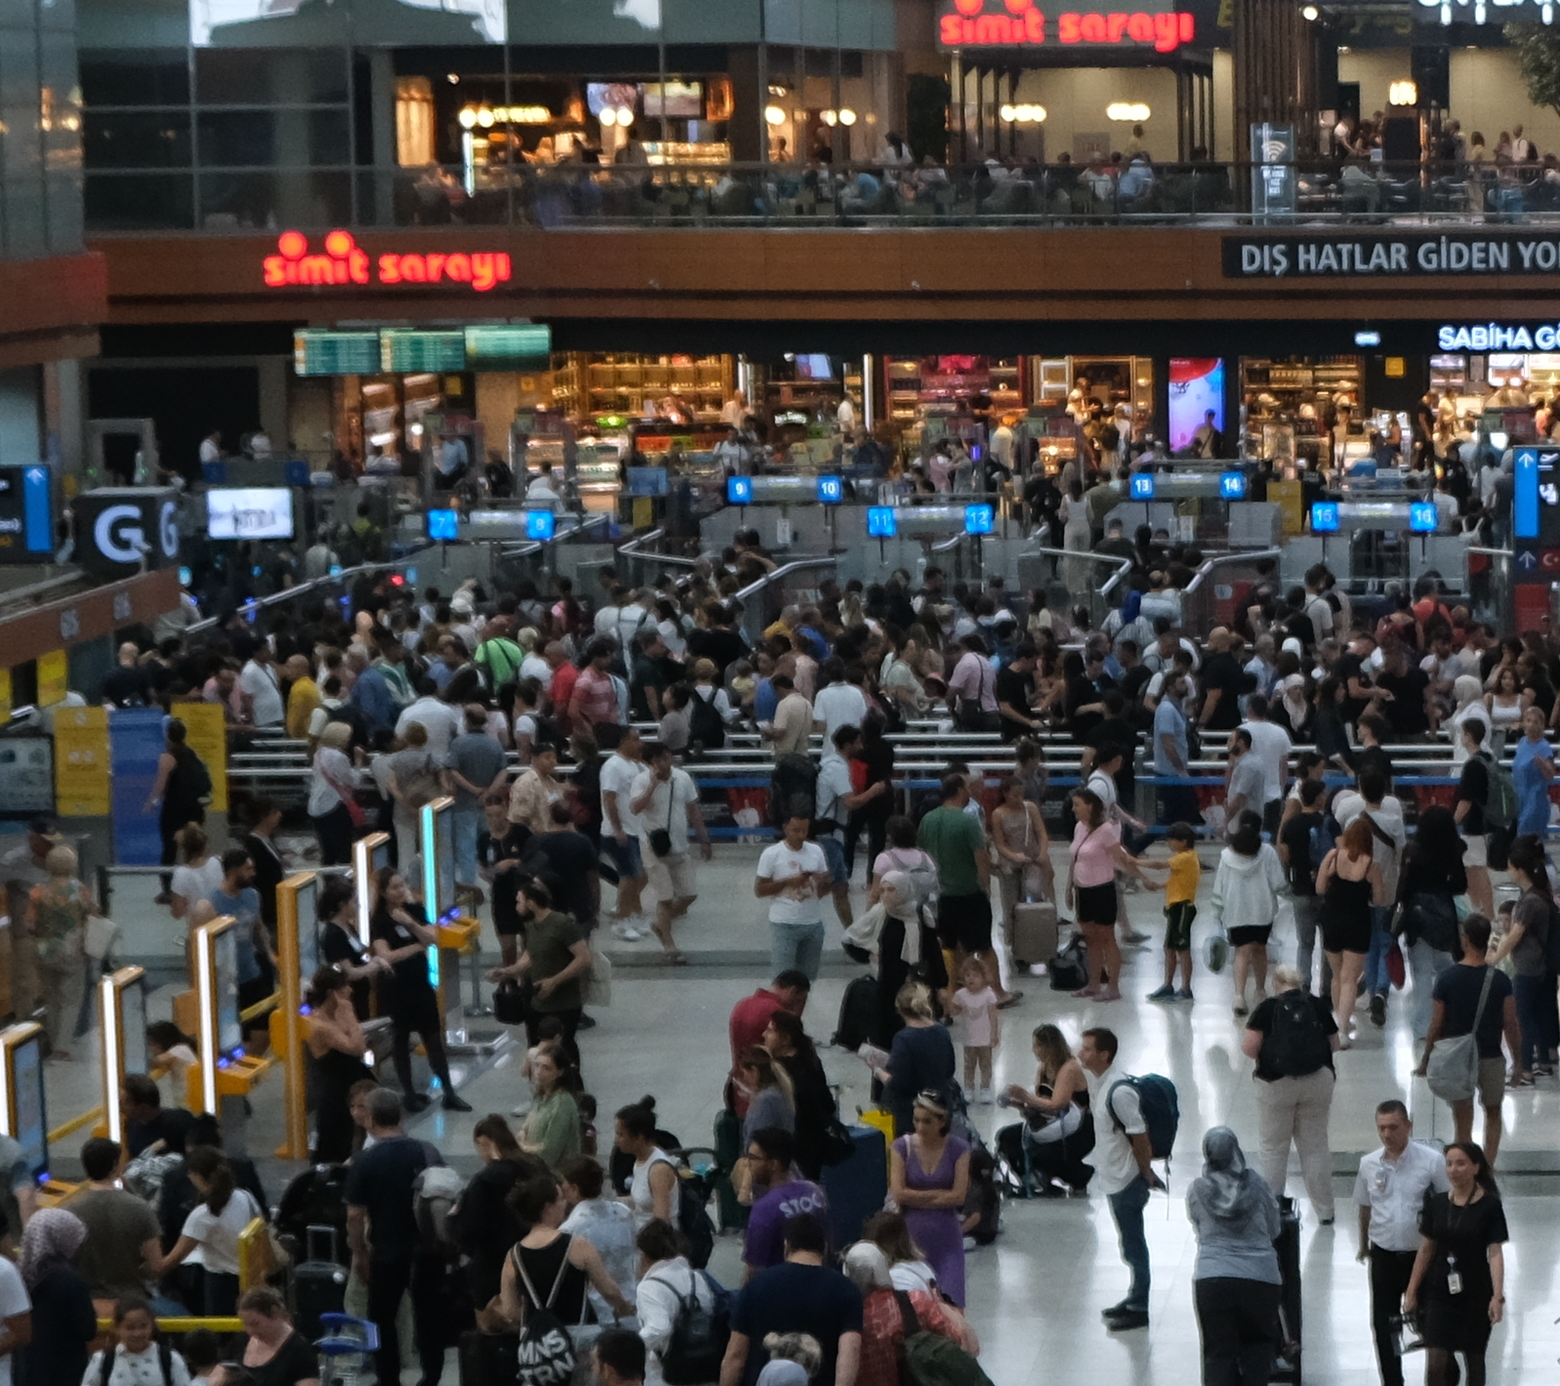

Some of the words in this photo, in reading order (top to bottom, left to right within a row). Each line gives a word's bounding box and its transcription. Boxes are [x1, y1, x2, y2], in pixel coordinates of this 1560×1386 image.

[1058, 11, 1195, 53] sarayı
[263, 230, 368, 286] simit
[378, 252, 511, 291] sarayı
[1241, 244, 1289, 277] DIŞ
[1298, 244, 1408, 271] HATLAR
[1417, 235, 1509, 270] GİDEN
[1438, 322, 1531, 351] SABİHA
[93, 504, 151, 564] G
